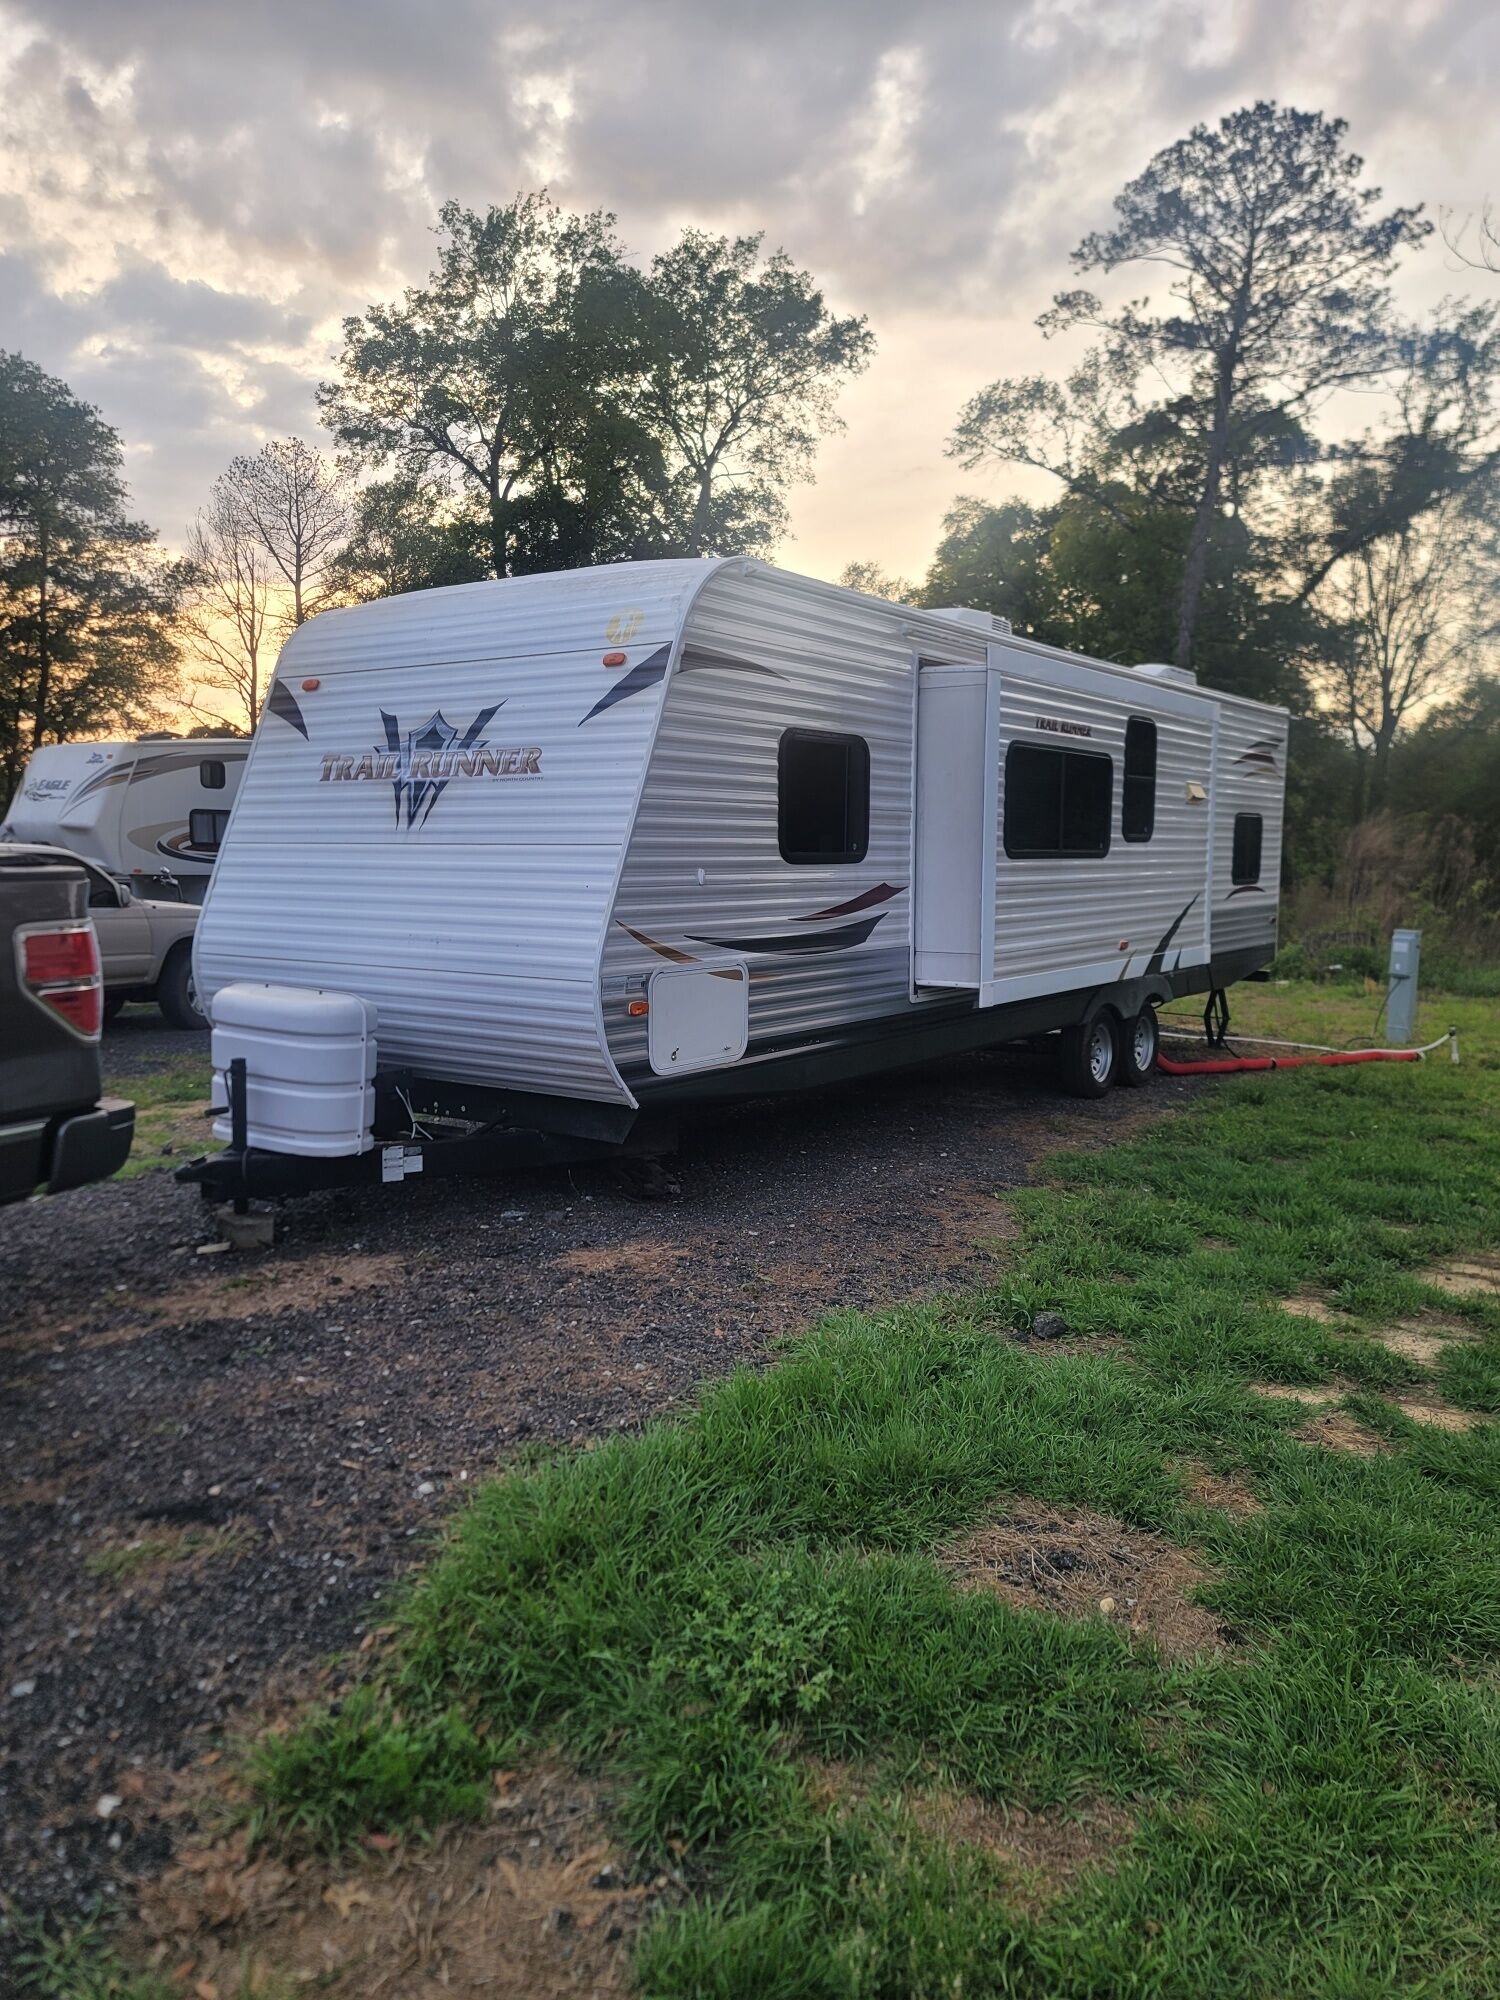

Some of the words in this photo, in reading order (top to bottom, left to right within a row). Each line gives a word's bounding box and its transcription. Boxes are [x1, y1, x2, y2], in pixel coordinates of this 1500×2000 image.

[1035, 717, 1058, 732] TRAIL
[1060, 721, 1092, 737] RUNNER
[319, 752, 399, 781] TRAIL
[408, 747, 543, 779] RUNNER
[36, 779, 71, 791] EAGLE
